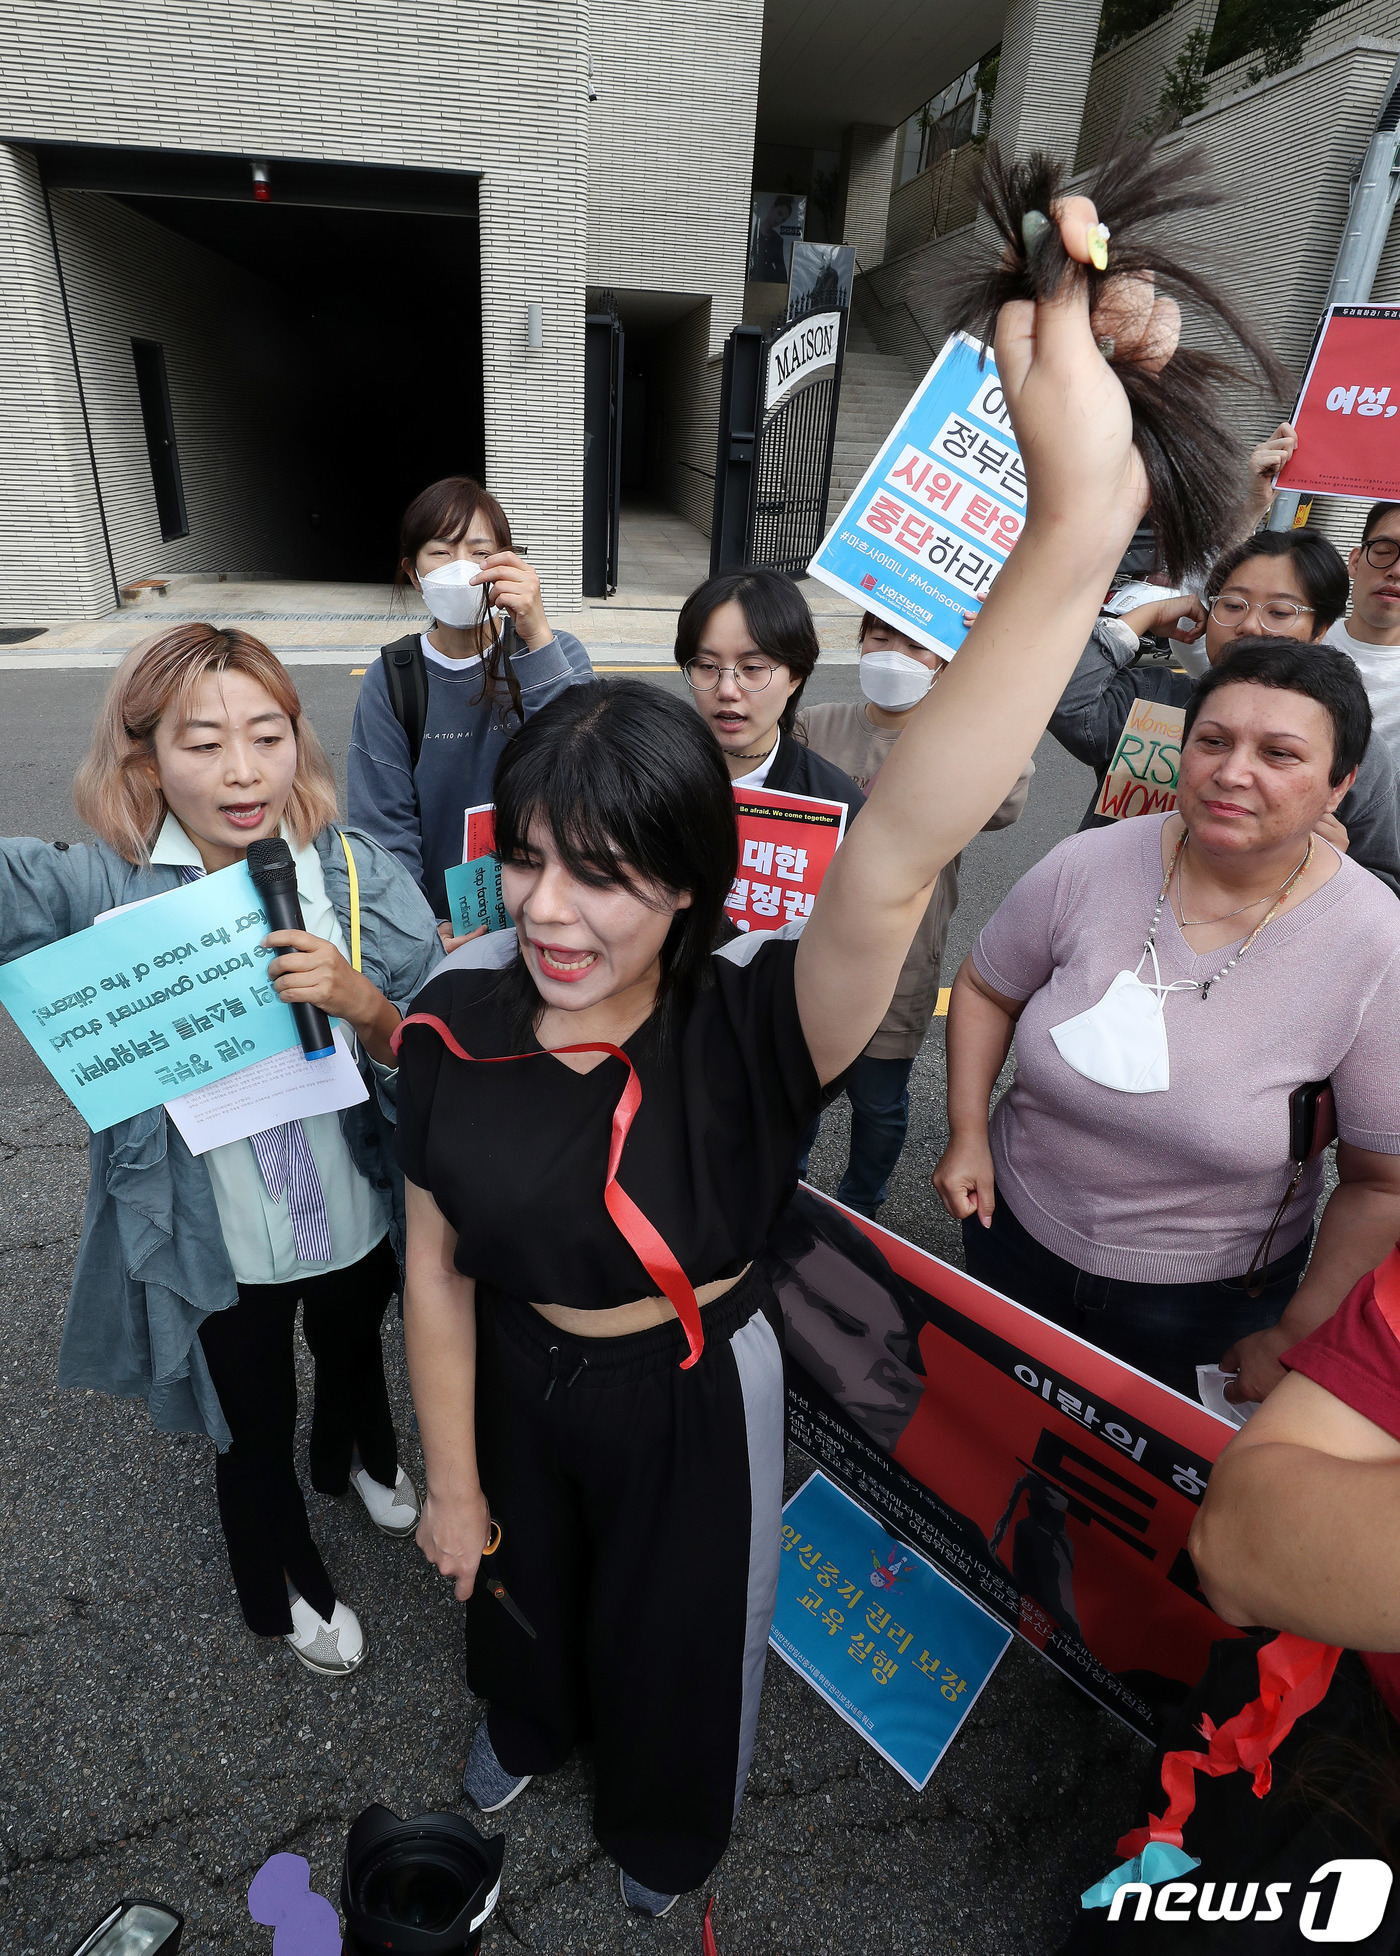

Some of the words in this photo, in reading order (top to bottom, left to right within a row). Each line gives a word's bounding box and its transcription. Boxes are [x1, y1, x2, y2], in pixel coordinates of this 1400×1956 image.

[775, 325, 833, 386] MAISON
[1326, 386, 1398, 418] 여성,
[942, 420, 1027, 499] 정부는
[892, 455, 963, 512] 시위
[839, 530, 909, 579] #마흐사아미니
[877, 583, 934, 623] 사회진보연대
[1129, 700, 1184, 739] Wome
[750, 807, 771, 816] afraid.
[772, 809, 783, 817] We
[784, 812, 803, 820] come
[804, 813, 834, 823] together
[742, 838, 809, 883] 대한
[200, 926, 232, 948] the
[234, 908, 268, 934] fear
[132, 962, 150, 982] of
[153, 942, 199, 968] voice
[196, 952, 255, 985] Iranian
[100, 971, 131, 992] the
[106, 974, 195, 1028] government
[49, 1018, 103, 1053] should
[171, 996, 248, 1041] 목소리를
[70, 1029, 171, 1087] 두려워하라!
[214, 1035, 257, 1063] 이란
[153, 1053, 214, 1086] 정부는
[1013, 1364, 1148, 1462] 이란의
[796, 1587, 845, 1636] 교육
[847, 1632, 899, 1685] 실행
[865, 1600, 914, 1655] 권리
[911, 1649, 968, 1702] 보장
